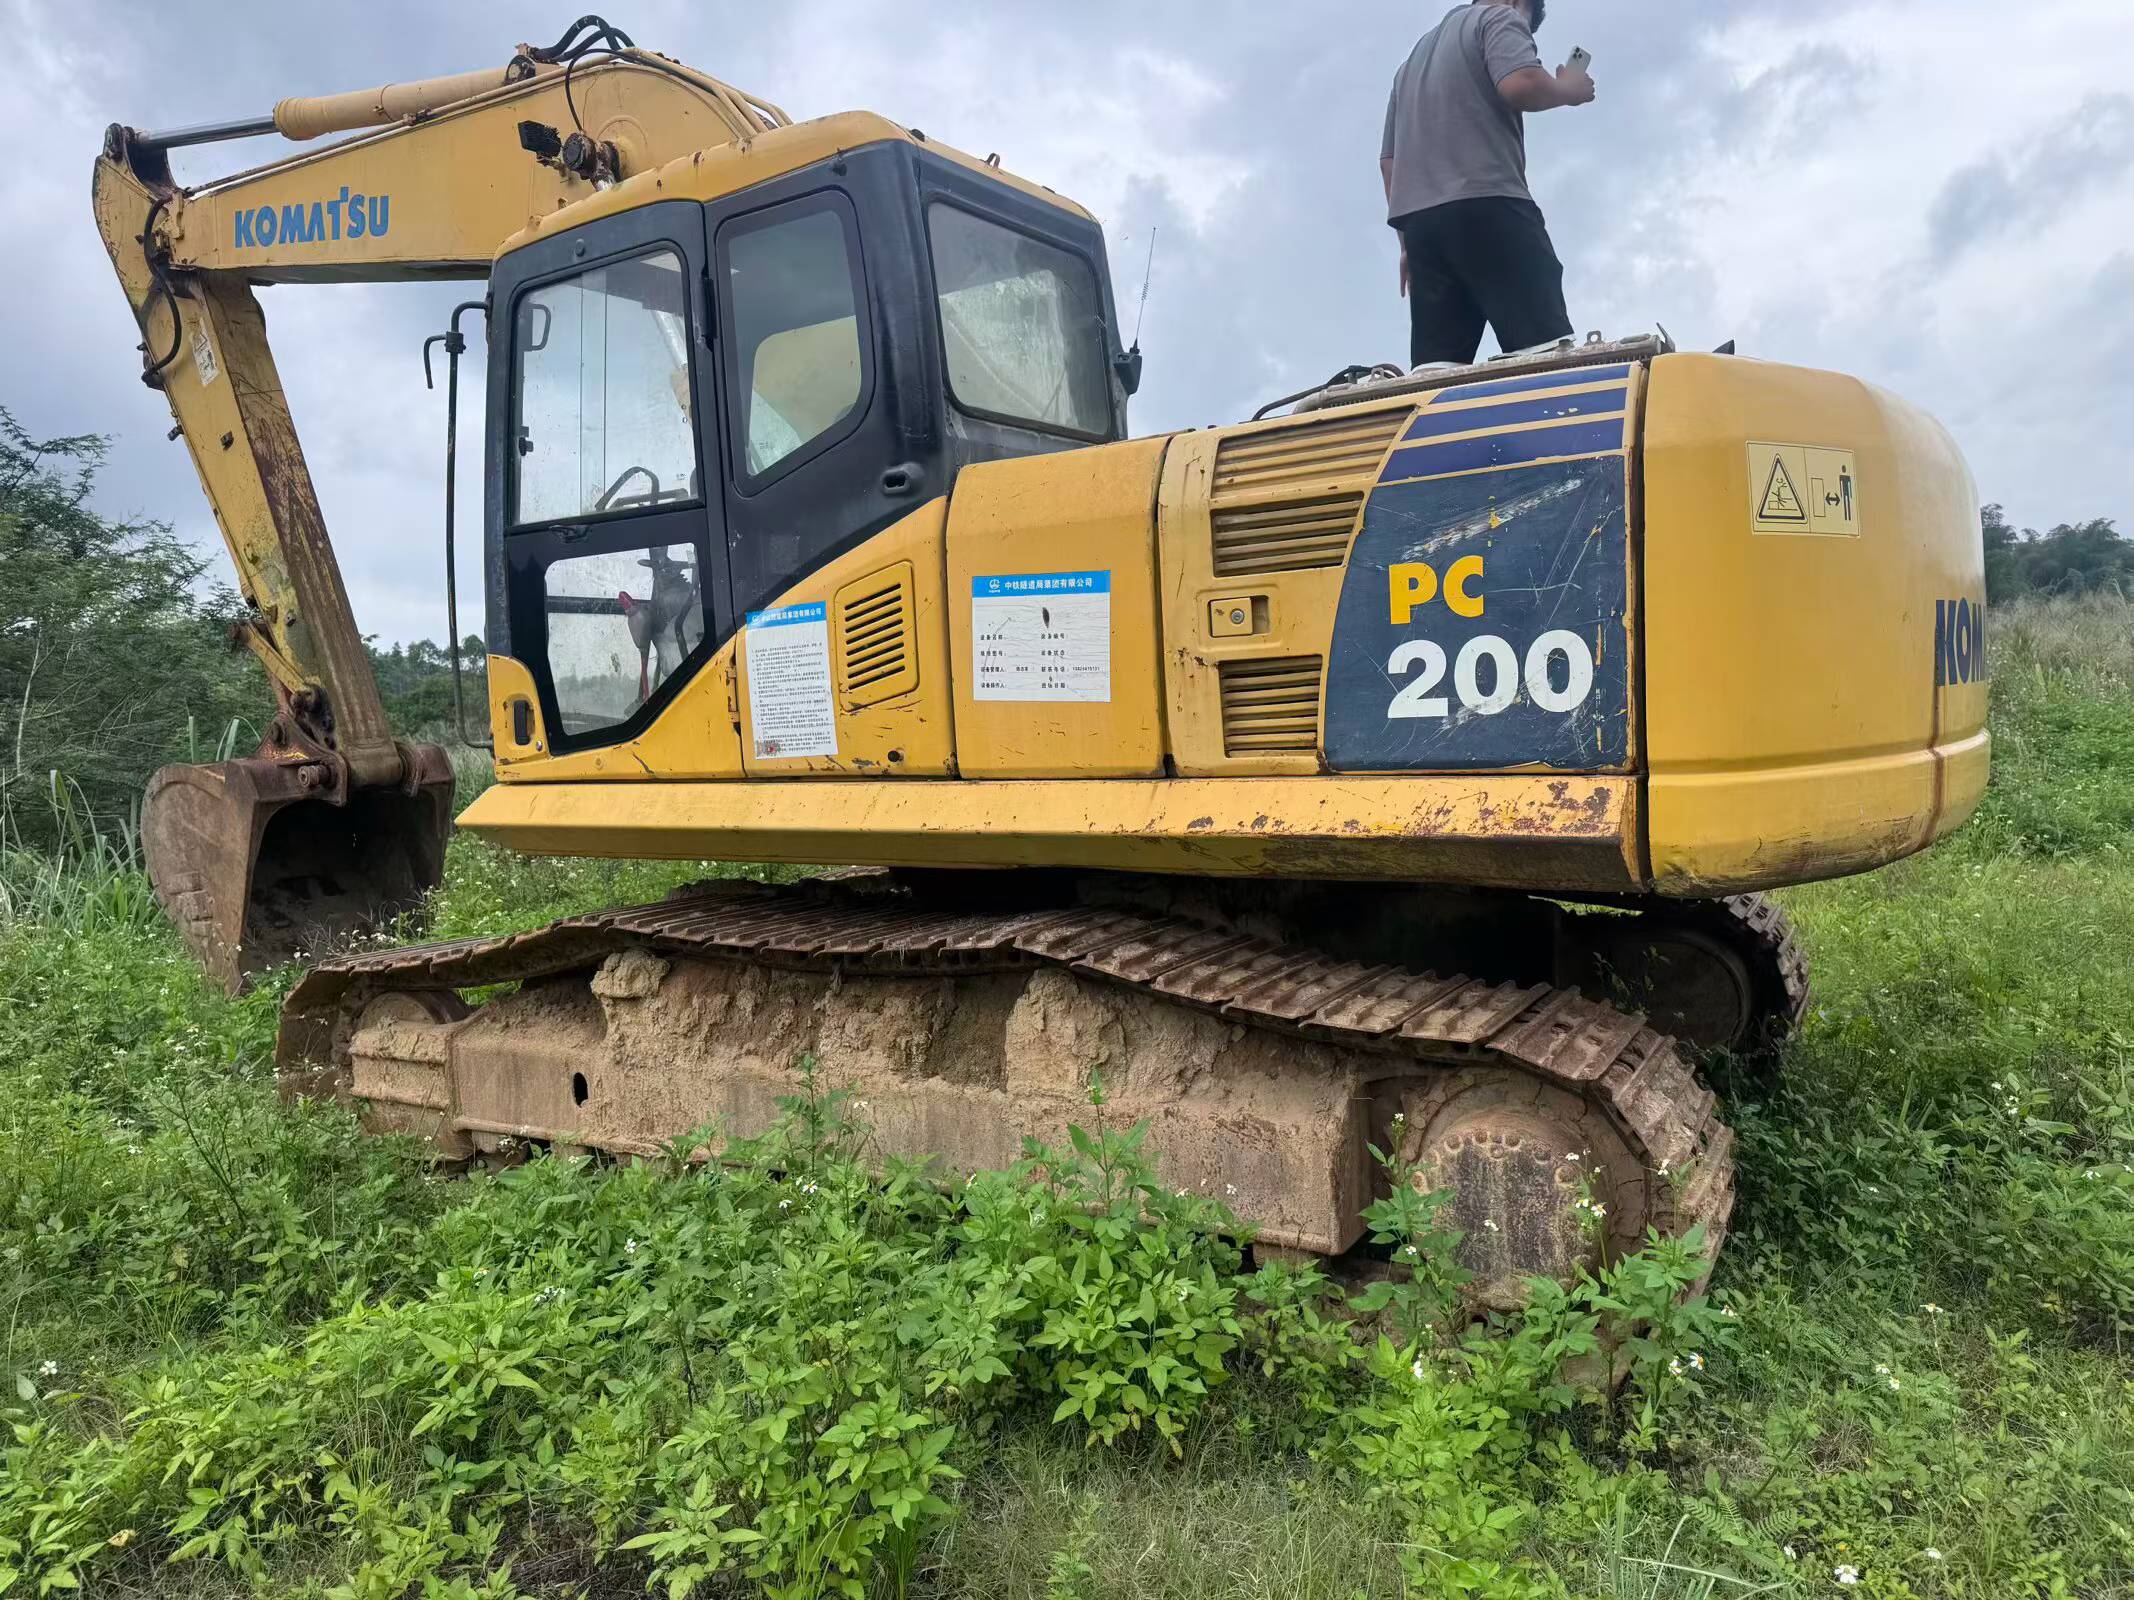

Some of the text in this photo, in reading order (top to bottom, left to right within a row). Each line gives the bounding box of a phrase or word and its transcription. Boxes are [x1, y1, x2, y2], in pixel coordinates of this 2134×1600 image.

[235, 187, 389, 248] KOMATSU
[761, 607, 822, 622] 局集团有限公司
[1389, 555, 1484, 625] PC
[1387, 629, 1593, 719] 200
